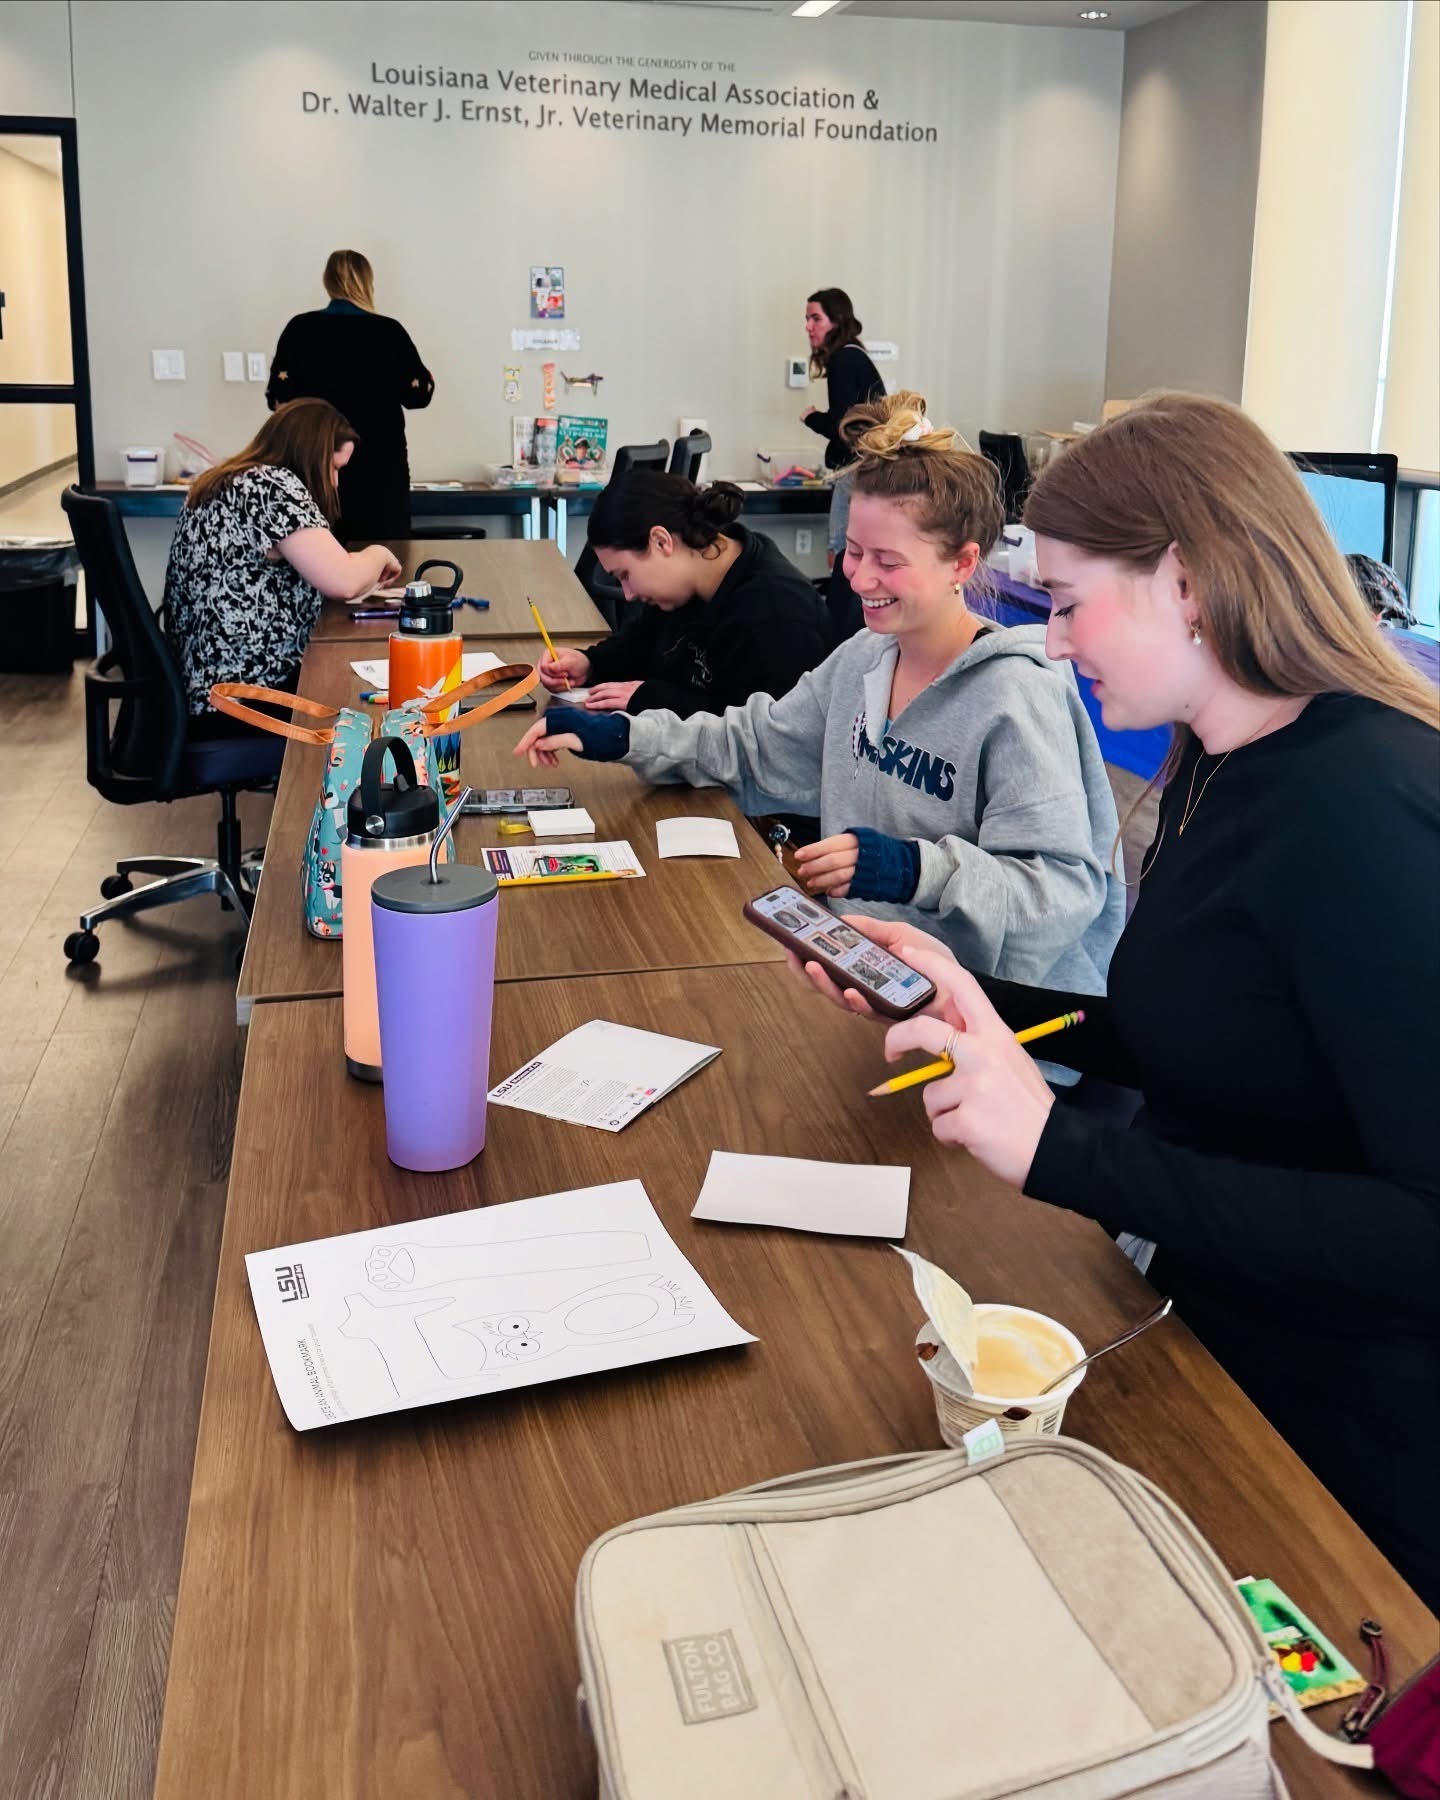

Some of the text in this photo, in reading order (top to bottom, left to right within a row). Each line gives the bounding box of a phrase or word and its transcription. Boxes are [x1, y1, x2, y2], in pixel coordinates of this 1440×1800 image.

[528, 50, 736, 73] GIVEN THROUGH THE GENEROSITY OF THE
[371, 62, 879, 110] Louisiana Veterinary Medical Association &
[302, 91, 938, 142] Dr. Walter J. Ernst, Jr. Veterinary Memorial Foundation
[492, 1083, 513, 1098] LSU
[275, 1265, 299, 1303] LSU
[296, 1338, 317, 1376] BOOKMARK
[679, 1640, 717, 1713] FULTON
[704, 1640, 740, 1709] BAG CO
